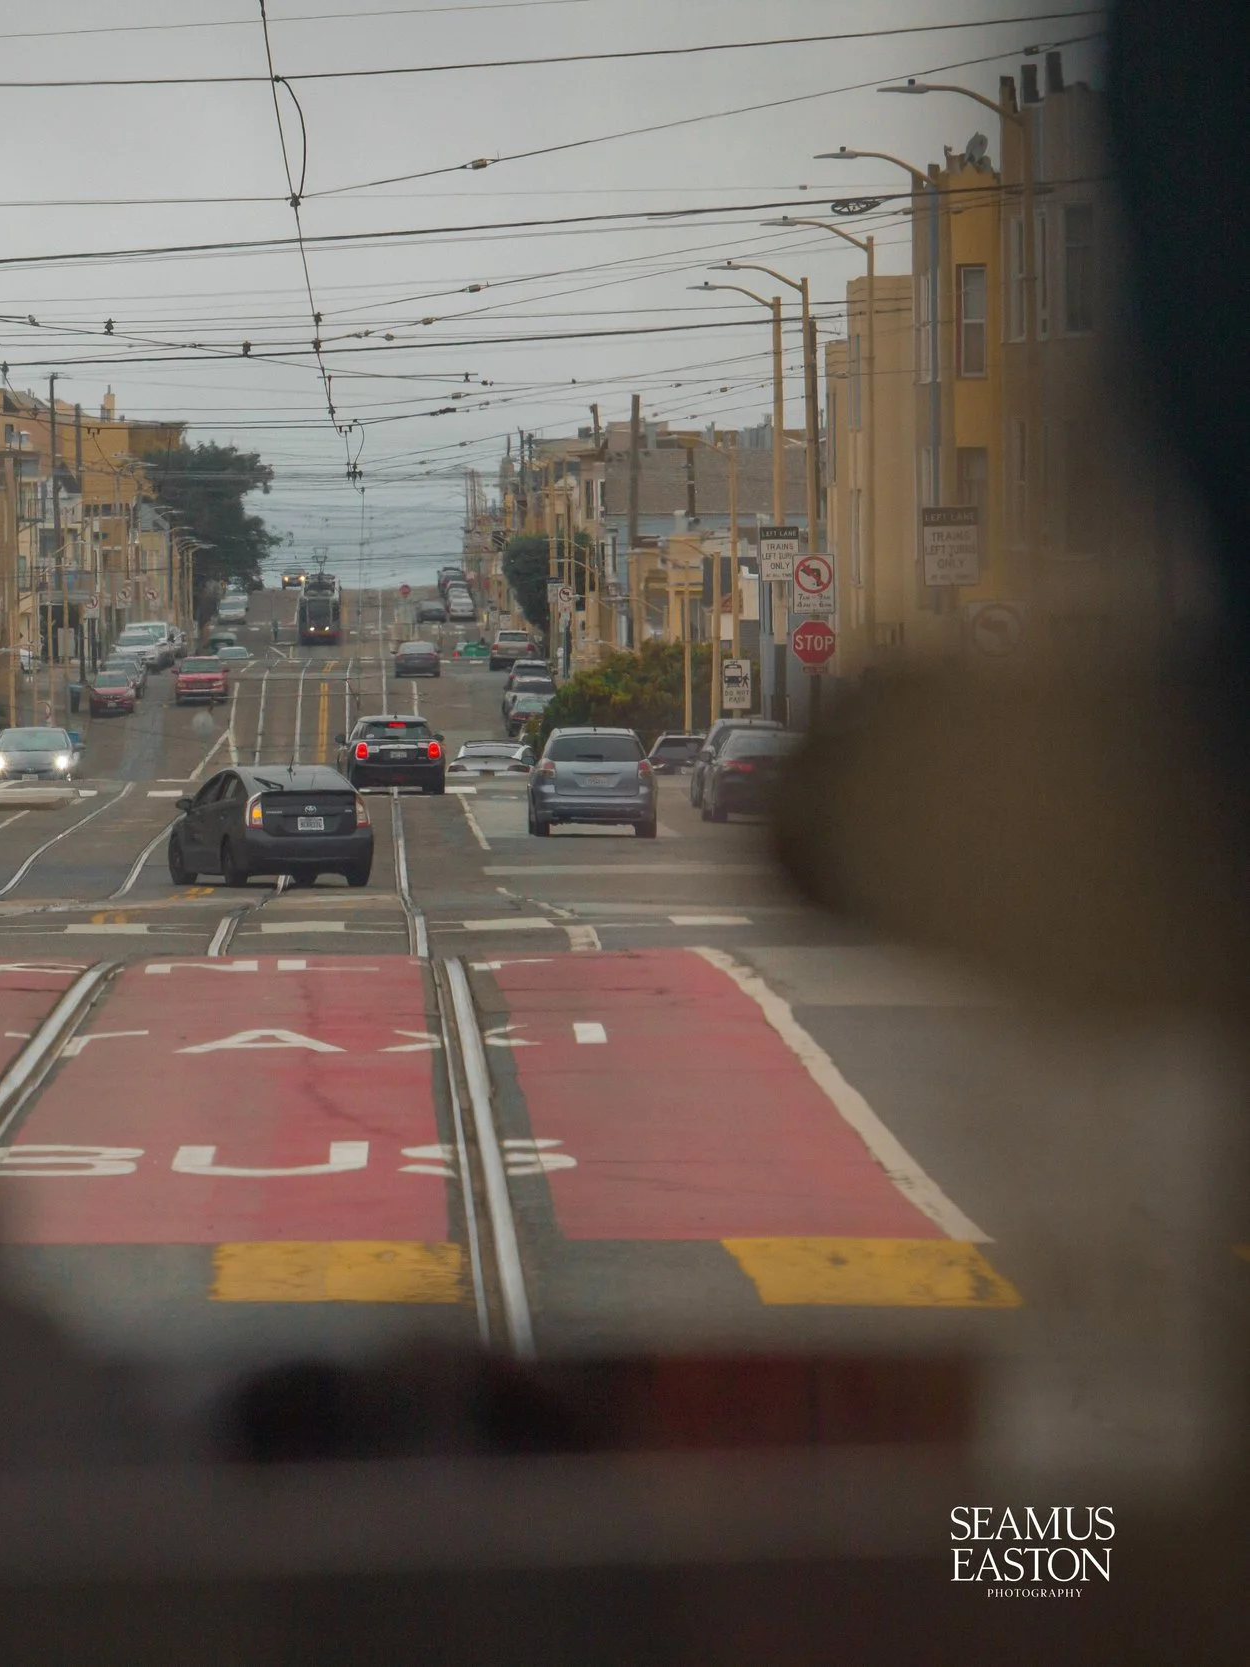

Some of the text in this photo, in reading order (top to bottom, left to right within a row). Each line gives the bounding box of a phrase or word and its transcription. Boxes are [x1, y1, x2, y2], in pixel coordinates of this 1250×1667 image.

[932, 531, 972, 542] TRAINS
[925, 544, 946, 556] LEFT
[761, 552, 776, 560] LEFT
[770, 562, 790, 570] ONLY
[937, 558, 965, 569] ONLY
[795, 635, 833, 651] STOP
[5, 1023, 608, 1054] TAXI
